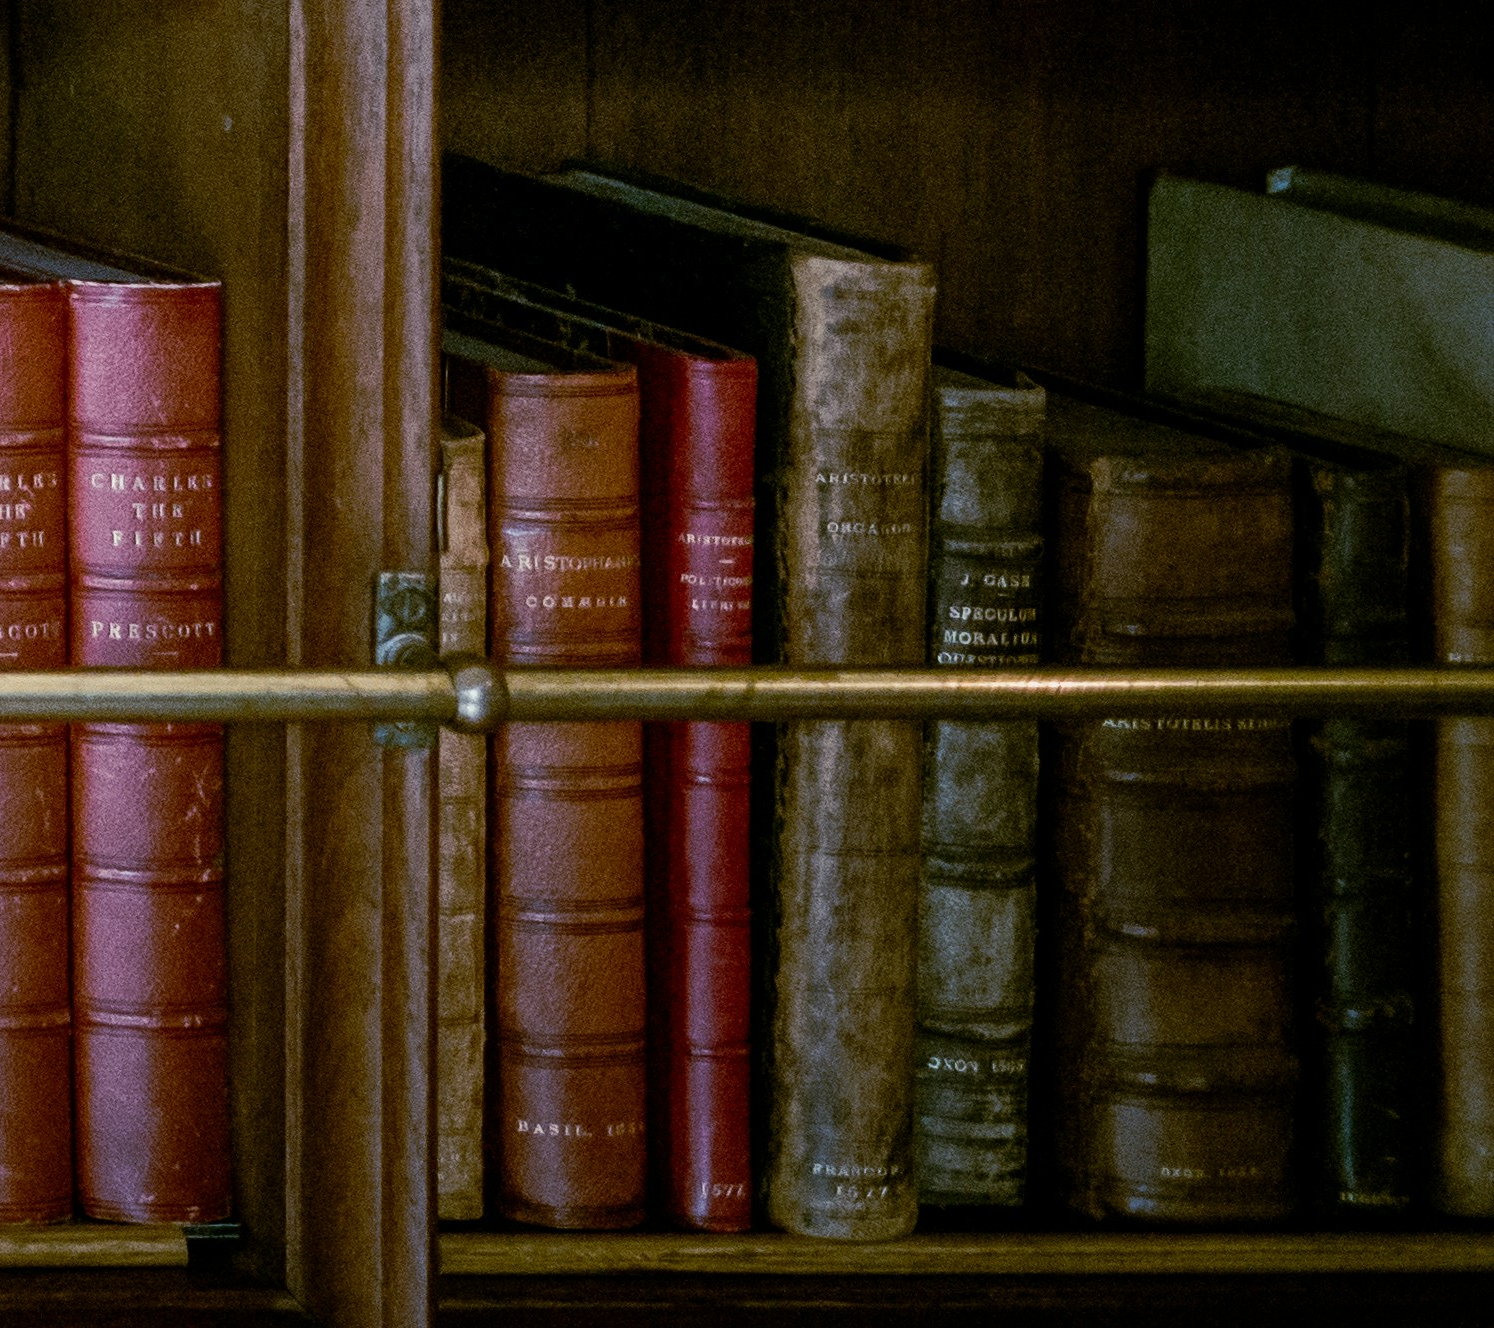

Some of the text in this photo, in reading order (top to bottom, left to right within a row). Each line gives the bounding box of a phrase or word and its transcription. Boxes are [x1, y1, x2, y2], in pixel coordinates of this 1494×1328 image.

[89, 471, 213, 492] CHARLES
[132, 500, 184, 520] THE
[112, 529, 202, 547] FIFTH
[91, 620, 217, 642] PRESCOTT
